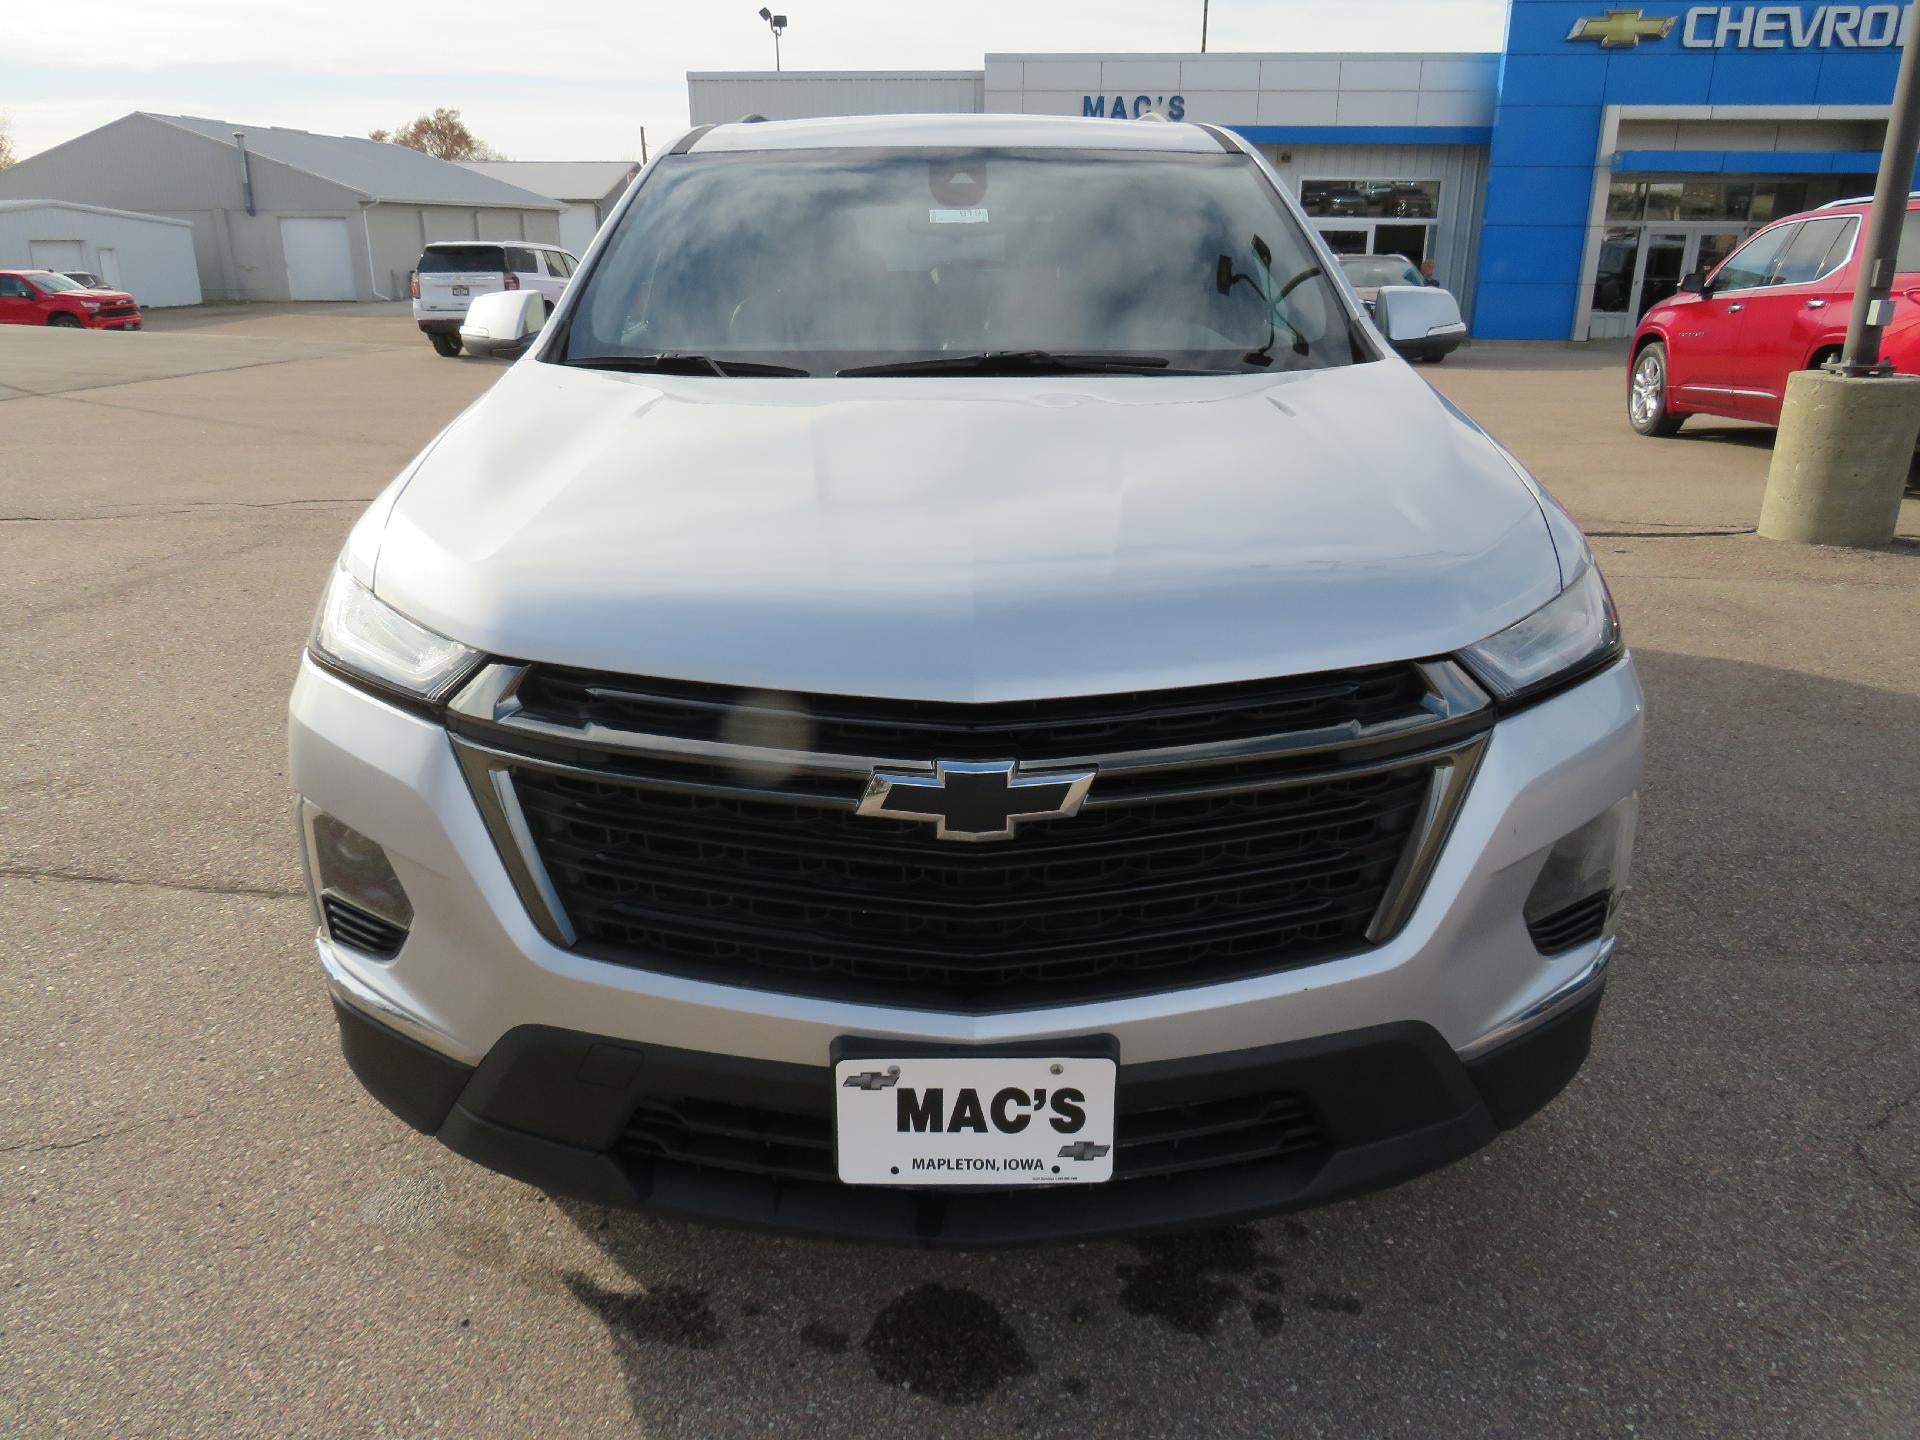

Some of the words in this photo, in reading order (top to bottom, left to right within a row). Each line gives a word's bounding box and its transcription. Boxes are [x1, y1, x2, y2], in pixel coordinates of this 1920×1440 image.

[1083, 95, 1185, 121] MAC'S
[896, 1086, 1086, 1134] MAC'S
[911, 1158, 1000, 1172] MAPLETON,
[1003, 1158, 1044, 1171] IOWA
